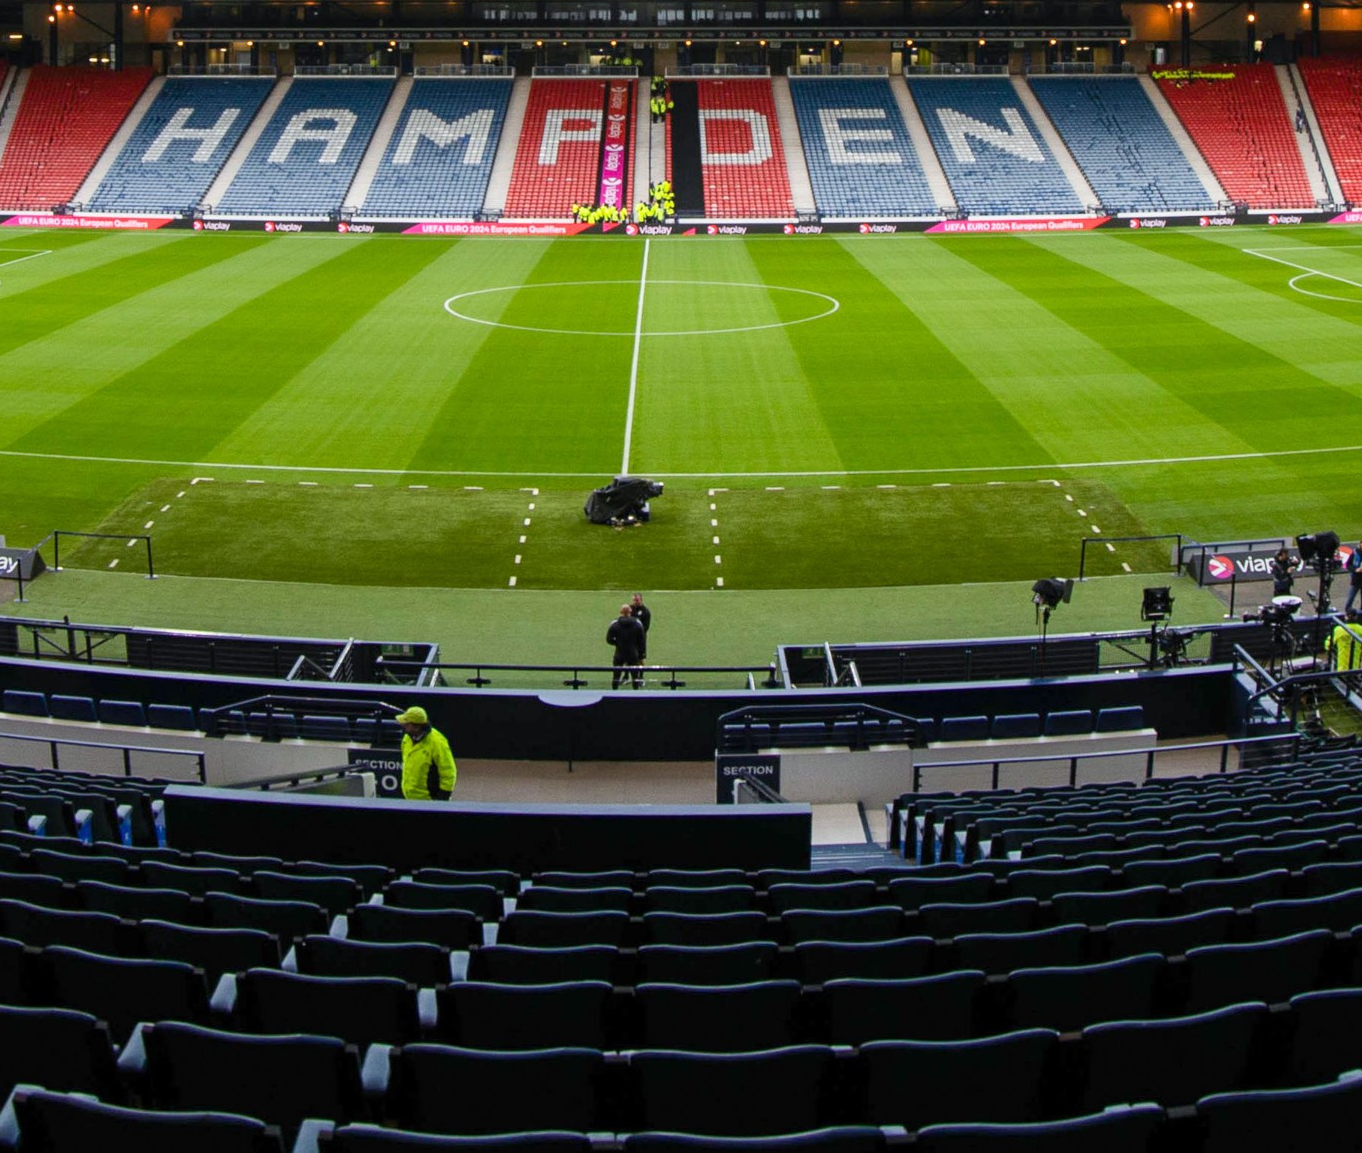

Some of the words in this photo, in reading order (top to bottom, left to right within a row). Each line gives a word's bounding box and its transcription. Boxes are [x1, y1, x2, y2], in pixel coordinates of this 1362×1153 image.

[141, 107, 1045, 166] HAMPDEN
[18, 217, 38, 225] UEFA
[39, 218, 61, 226] EURO
[61, 218, 79, 226] 2024
[80, 219, 114, 228] European
[114, 219, 148, 228] Qualifiers
[1140, 219, 1166, 228] viaplay
[1209, 216, 1236, 226] viaplay
[1276, 215, 1302, 225] viaplay
[204, 222, 230, 232] viaplay
[275, 223, 303, 233] viaplay
[348, 223, 375, 234] viaplay
[422, 225, 443, 233] UEFA
[445, 225, 468, 233] EURO
[470, 225, 490, 233] 2024
[491, 225, 527, 235] European
[529, 225, 566, 234] Qualifiers
[639, 225, 672, 235] viaplay
[718, 225, 747, 235] viaplay
[794, 225, 823, 235] viaplay
[869, 224, 897, 234] viaplay
[944, 223, 966, 232] UEFA
[967, 223, 990, 231] EURO
[991, 223, 1010, 231] 2024
[1011, 222, 1047, 232] European
[1047, 221, 1083, 230] Qualifiers
[1236, 556, 1304, 574] viapy
[723, 765, 774, 776] SECTION
